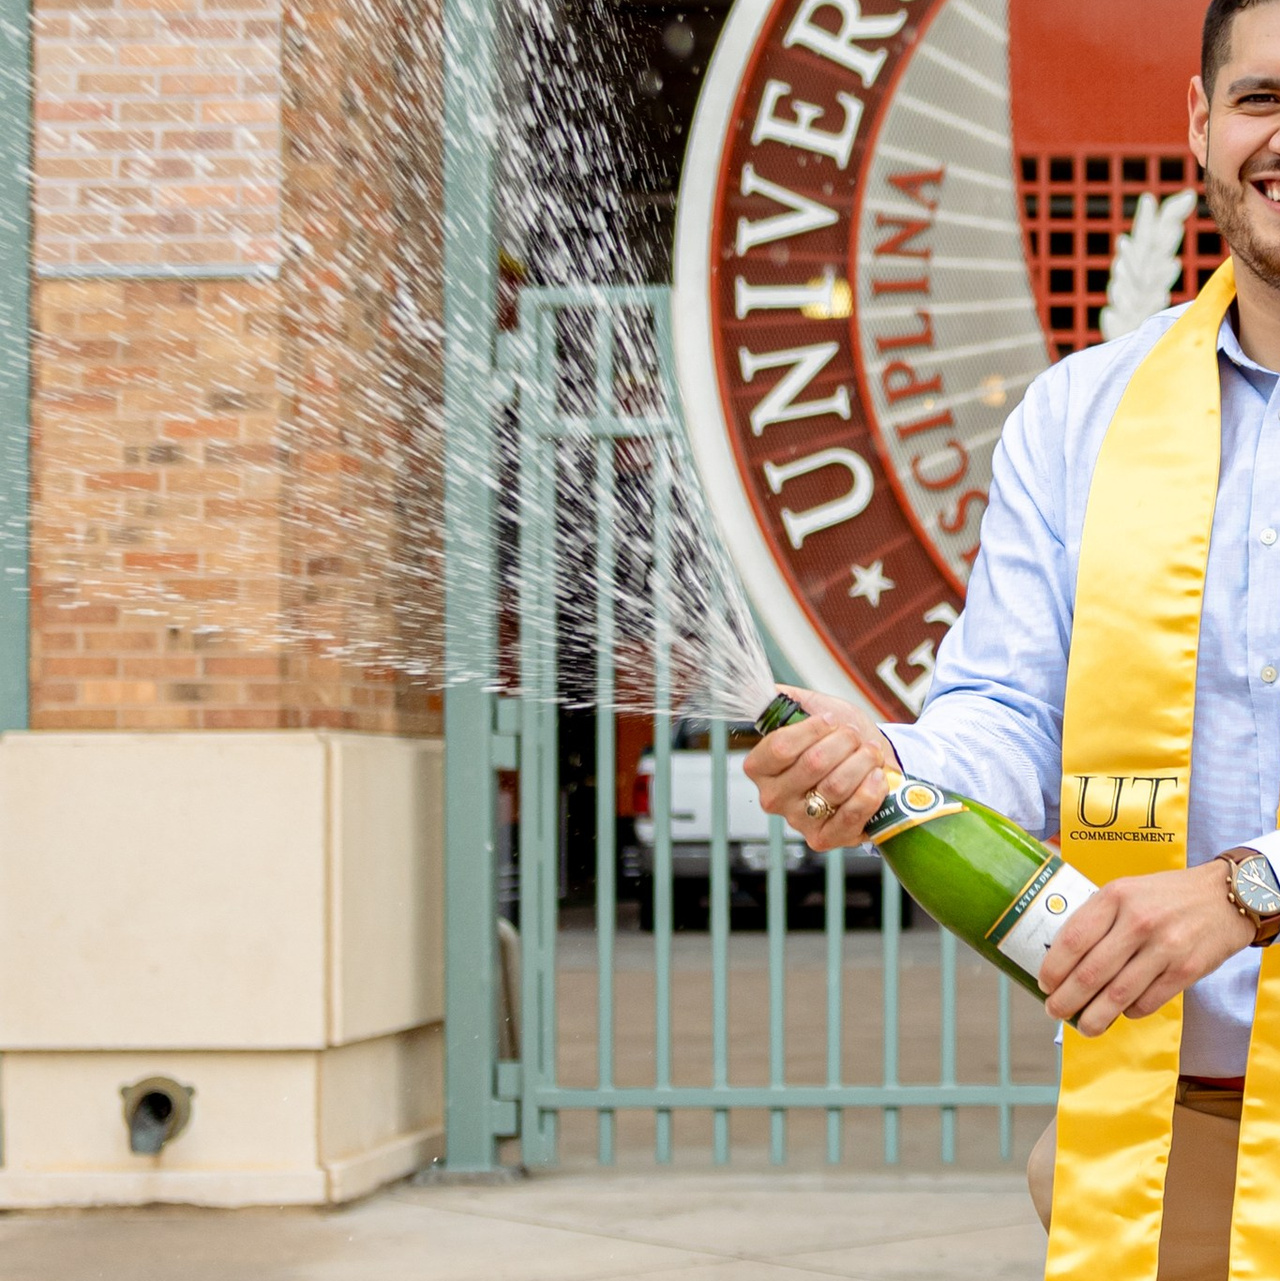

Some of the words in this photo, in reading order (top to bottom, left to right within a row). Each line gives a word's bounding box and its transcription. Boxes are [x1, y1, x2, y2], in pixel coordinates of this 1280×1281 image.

[872, 164, 990, 566] SCIPLINA
[1073, 775, 1178, 829] UT
[1069, 830, 1175, 842] COMMENCEMENT
[1015, 883, 1041, 914] EXTRA
[1039, 866, 1054, 883] DRY
